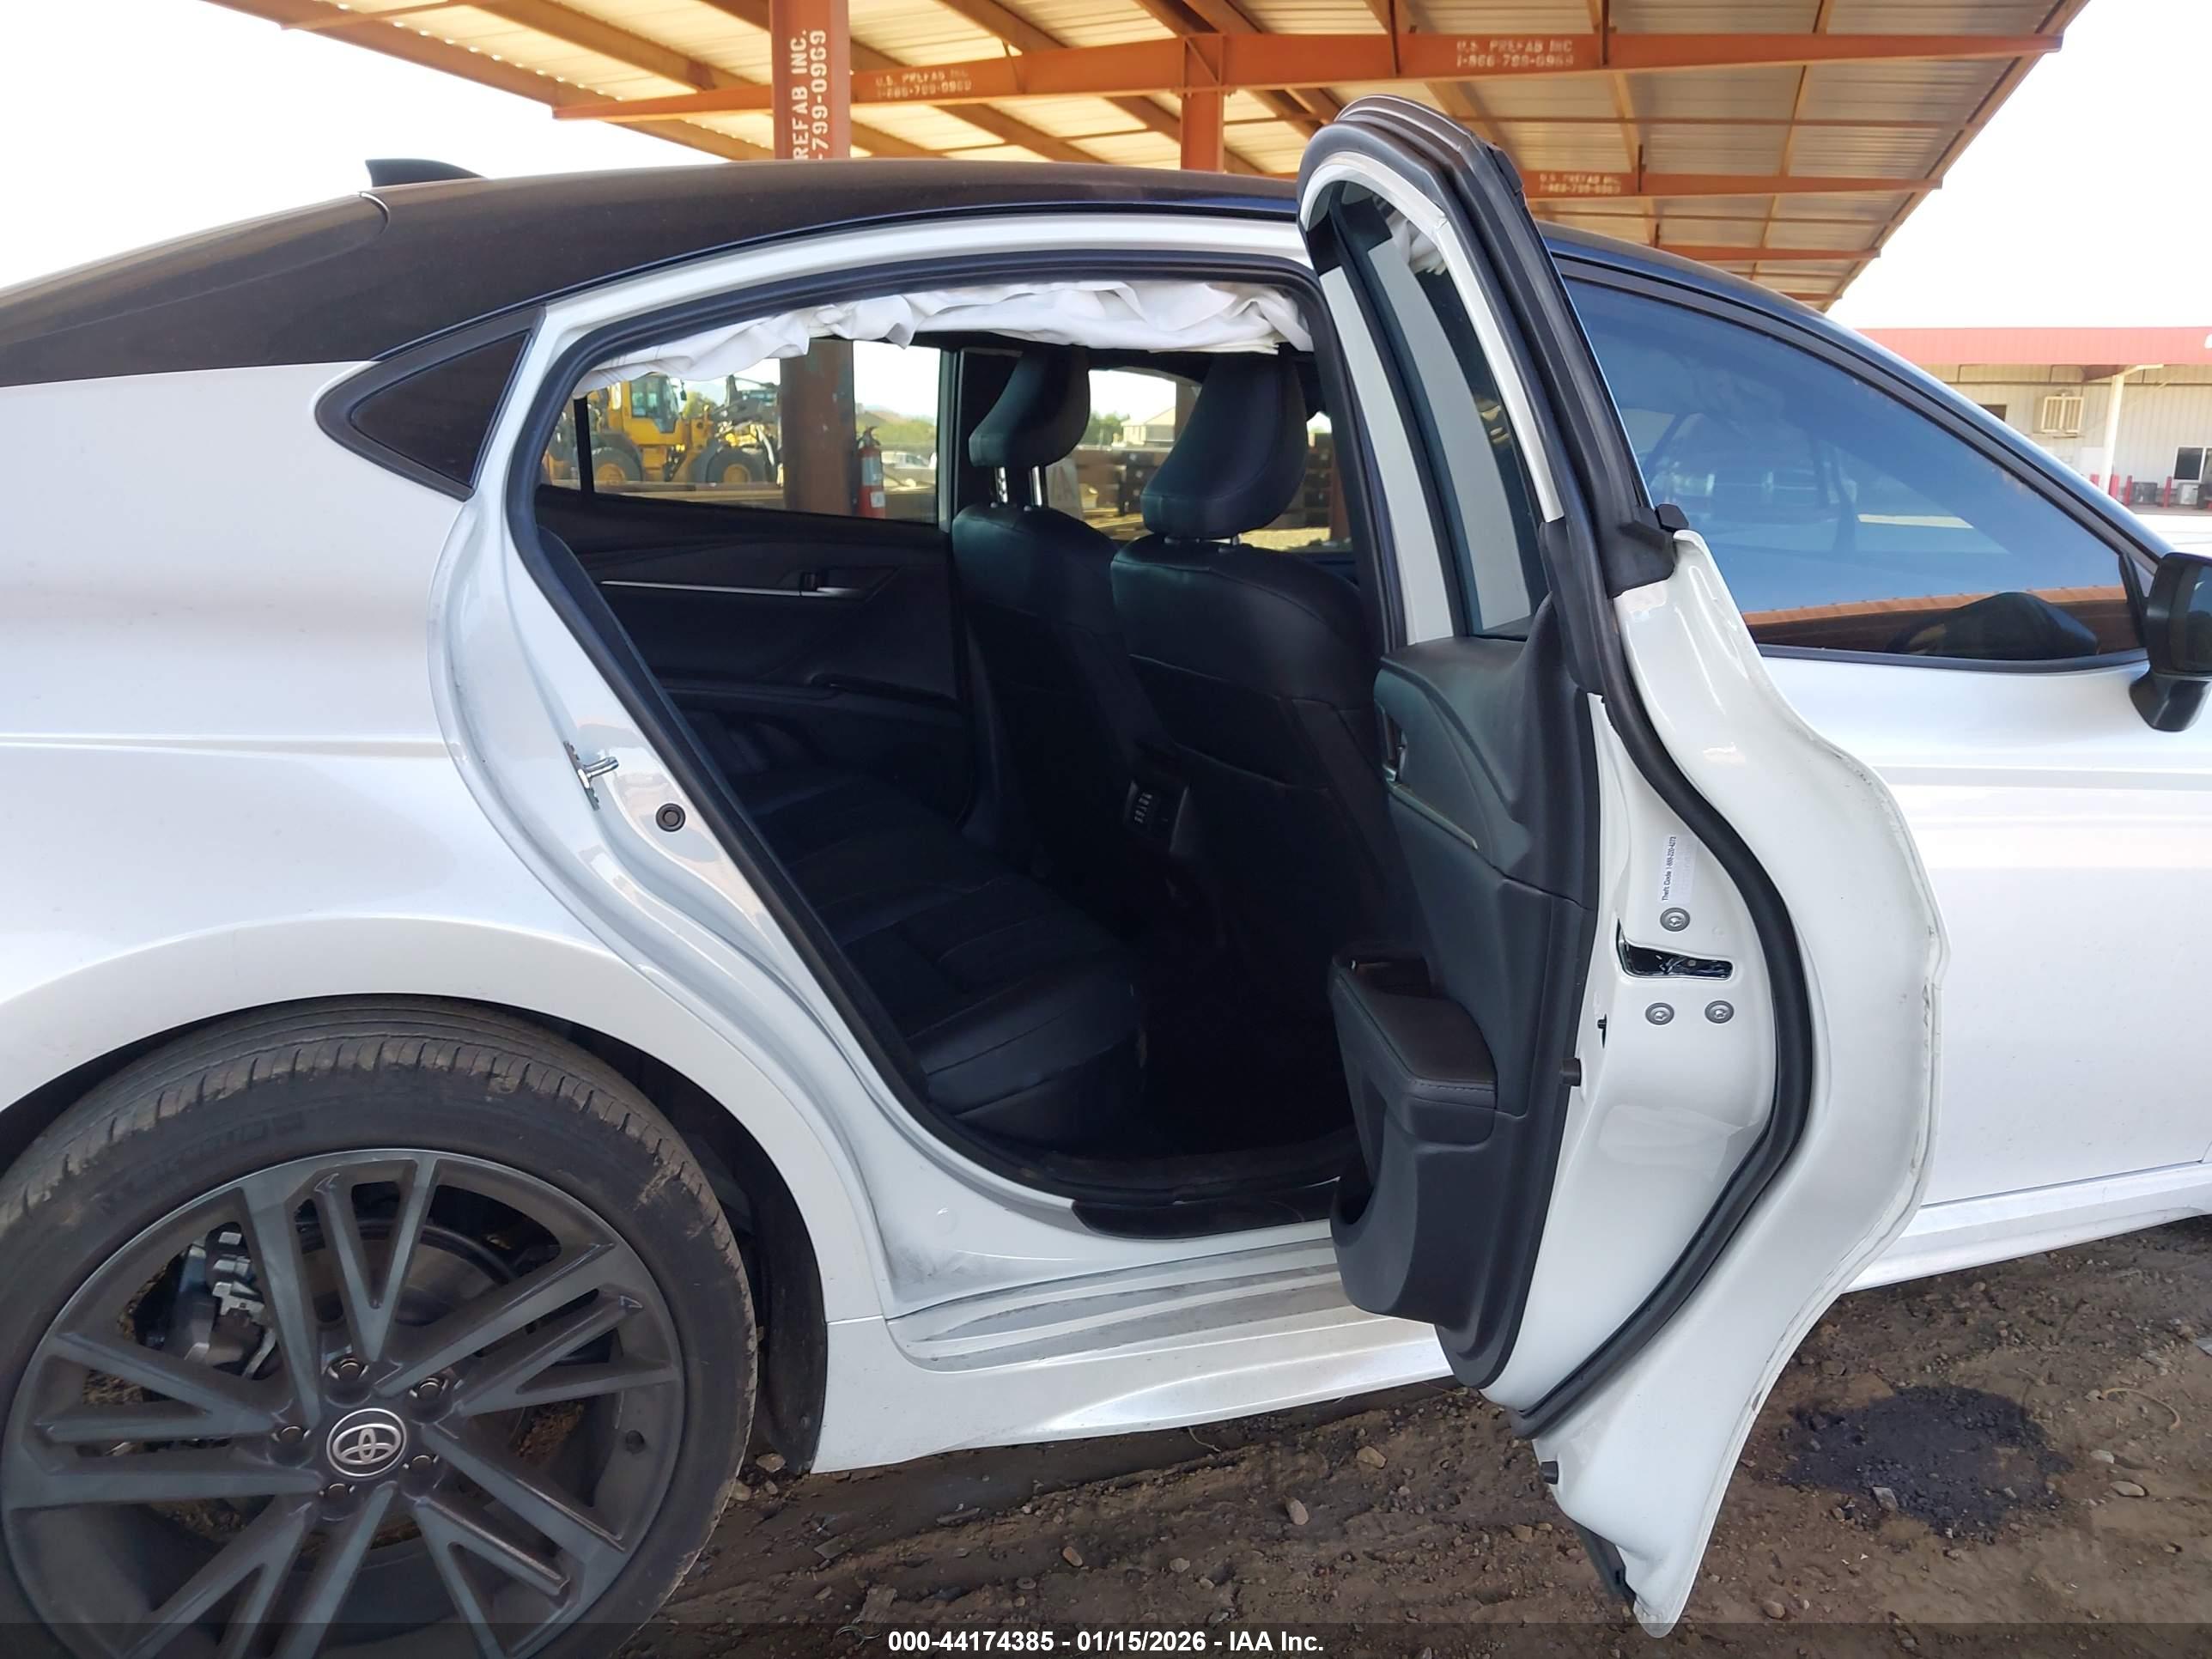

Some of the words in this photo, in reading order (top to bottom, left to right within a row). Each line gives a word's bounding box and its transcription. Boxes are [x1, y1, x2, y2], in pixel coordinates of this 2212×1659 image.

[790, 29, 808, 74] INC.
[1489, 40, 1543, 53] PREFAB
[810, 29, 828, 161] -799-0969
[791, 86, 809, 160] REFAB
[1663, 871, 1672, 885] Code
[1662, 886, 1670, 901] Theft
